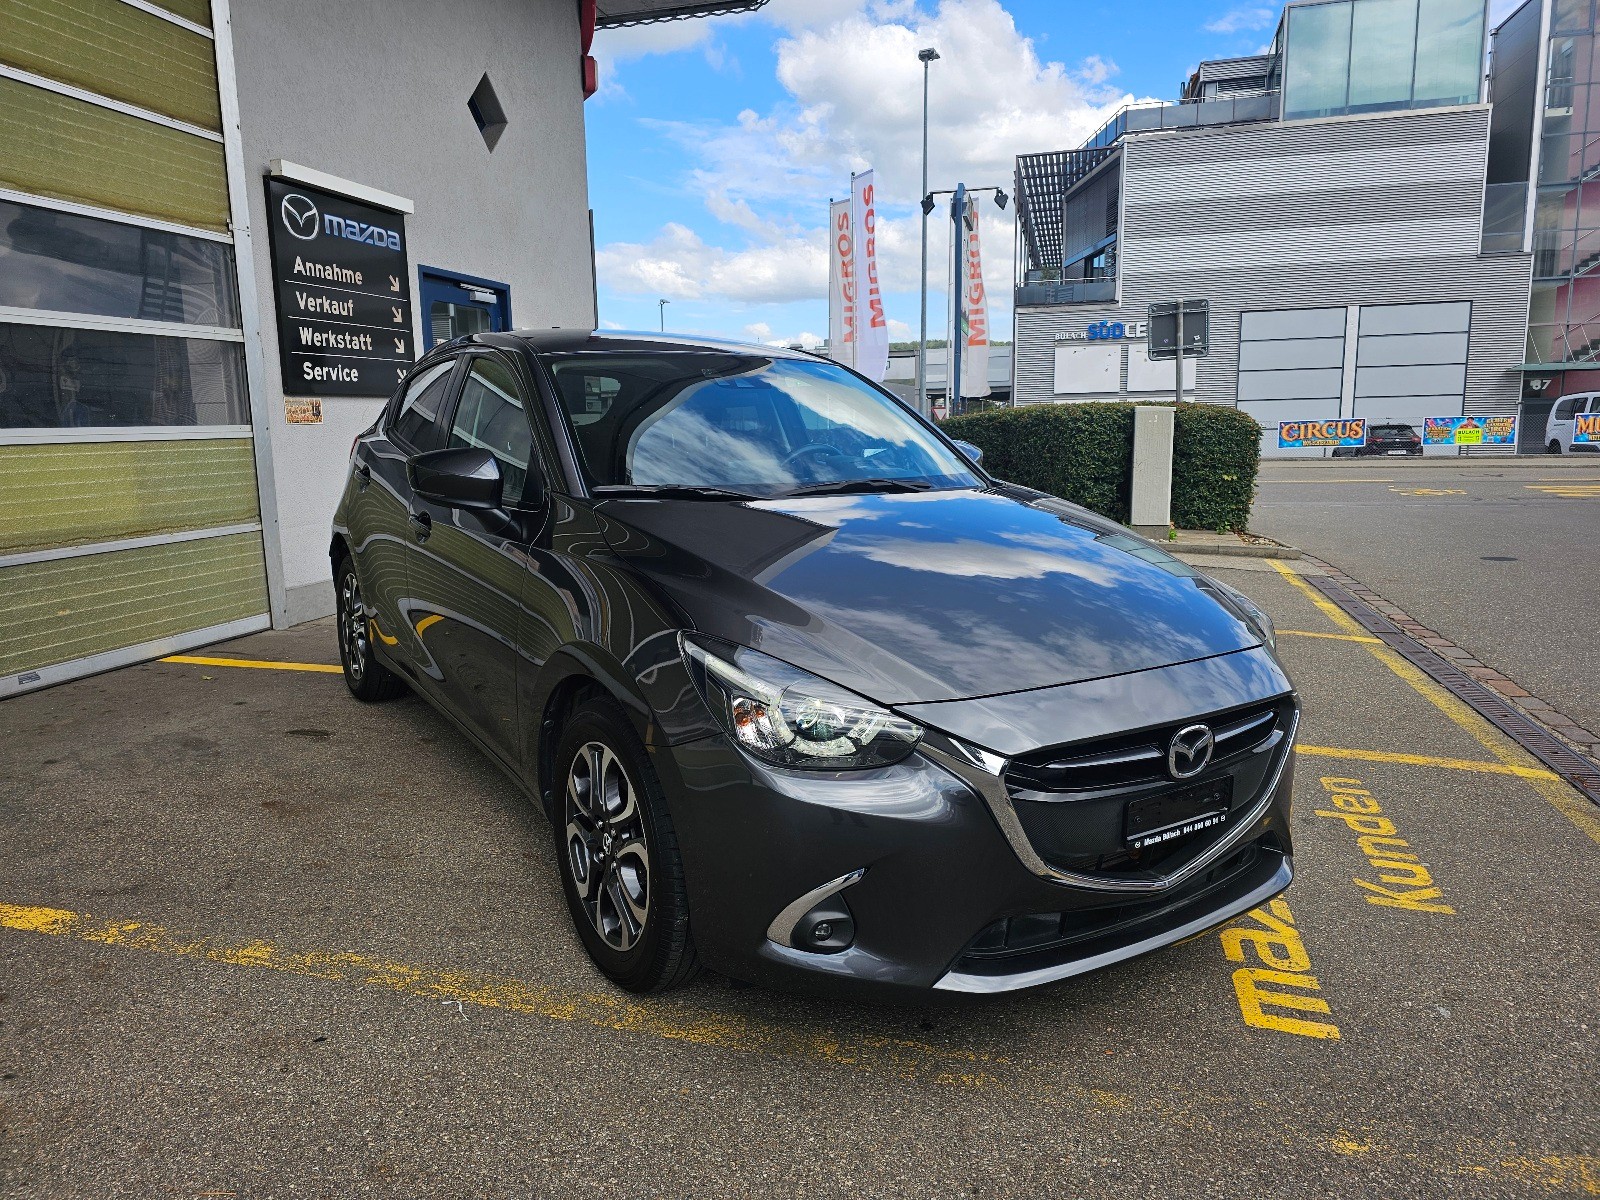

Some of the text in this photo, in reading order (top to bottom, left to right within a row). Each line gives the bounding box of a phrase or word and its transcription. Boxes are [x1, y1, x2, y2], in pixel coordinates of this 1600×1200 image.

[323, 213, 401, 251] mazda
[293, 255, 363, 286] Annahme
[838, 211, 857, 343] MIGROS
[296, 290, 354, 317] Verkauf
[299, 326, 373, 351] Werkstatt
[1087, 319, 1148, 340] SÜDCE
[303, 361, 359, 382] Service
[1281, 420, 1363, 442] CIRCUS
[1314, 776, 1457, 915] Kunden
[1219, 893, 1341, 1040] maz
